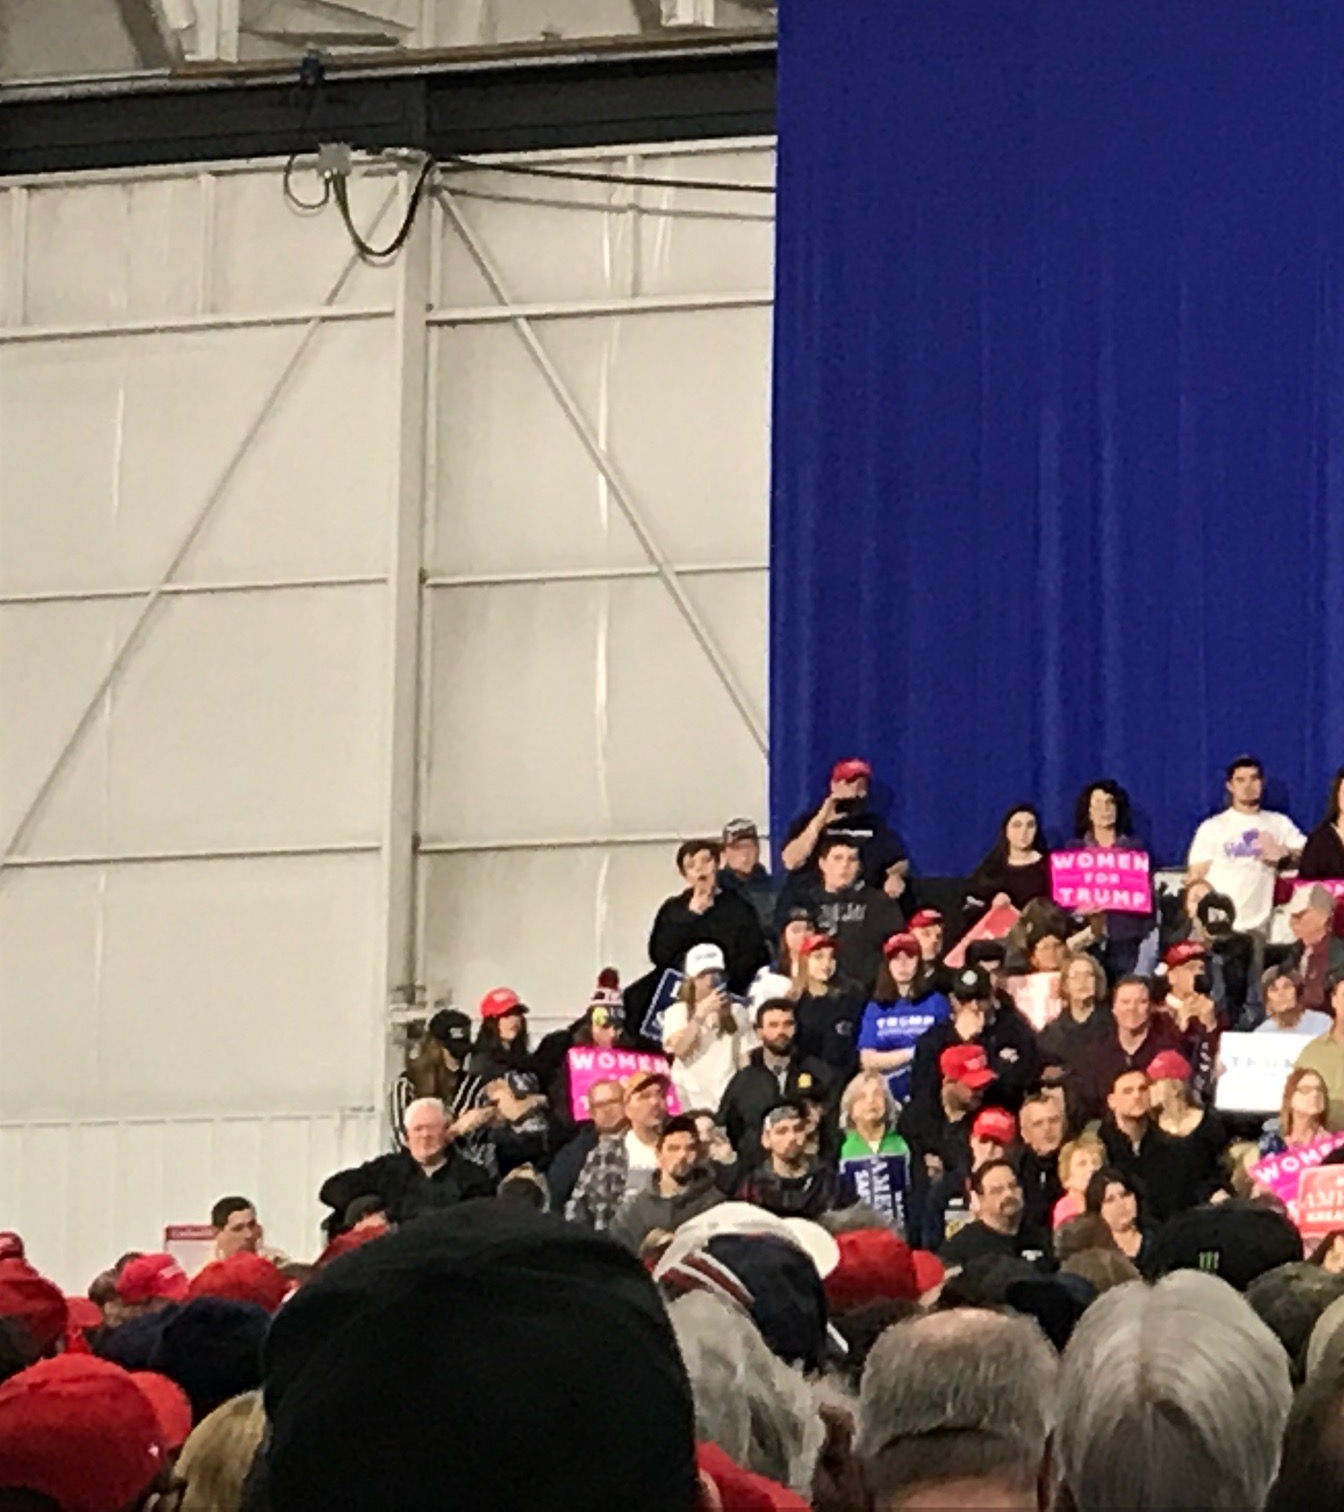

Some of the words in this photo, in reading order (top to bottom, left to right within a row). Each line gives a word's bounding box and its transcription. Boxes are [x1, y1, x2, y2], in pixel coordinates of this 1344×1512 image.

[1051, 852, 1149, 873] WOMEN
[1083, 872, 1120, 885] FOR
[1058, 887, 1147, 907] TRUMP
[876, 1015, 935, 1029] TRUMP
[569, 1050, 670, 1076] WOMEN
[1230, 1056, 1294, 1070] TRUM
